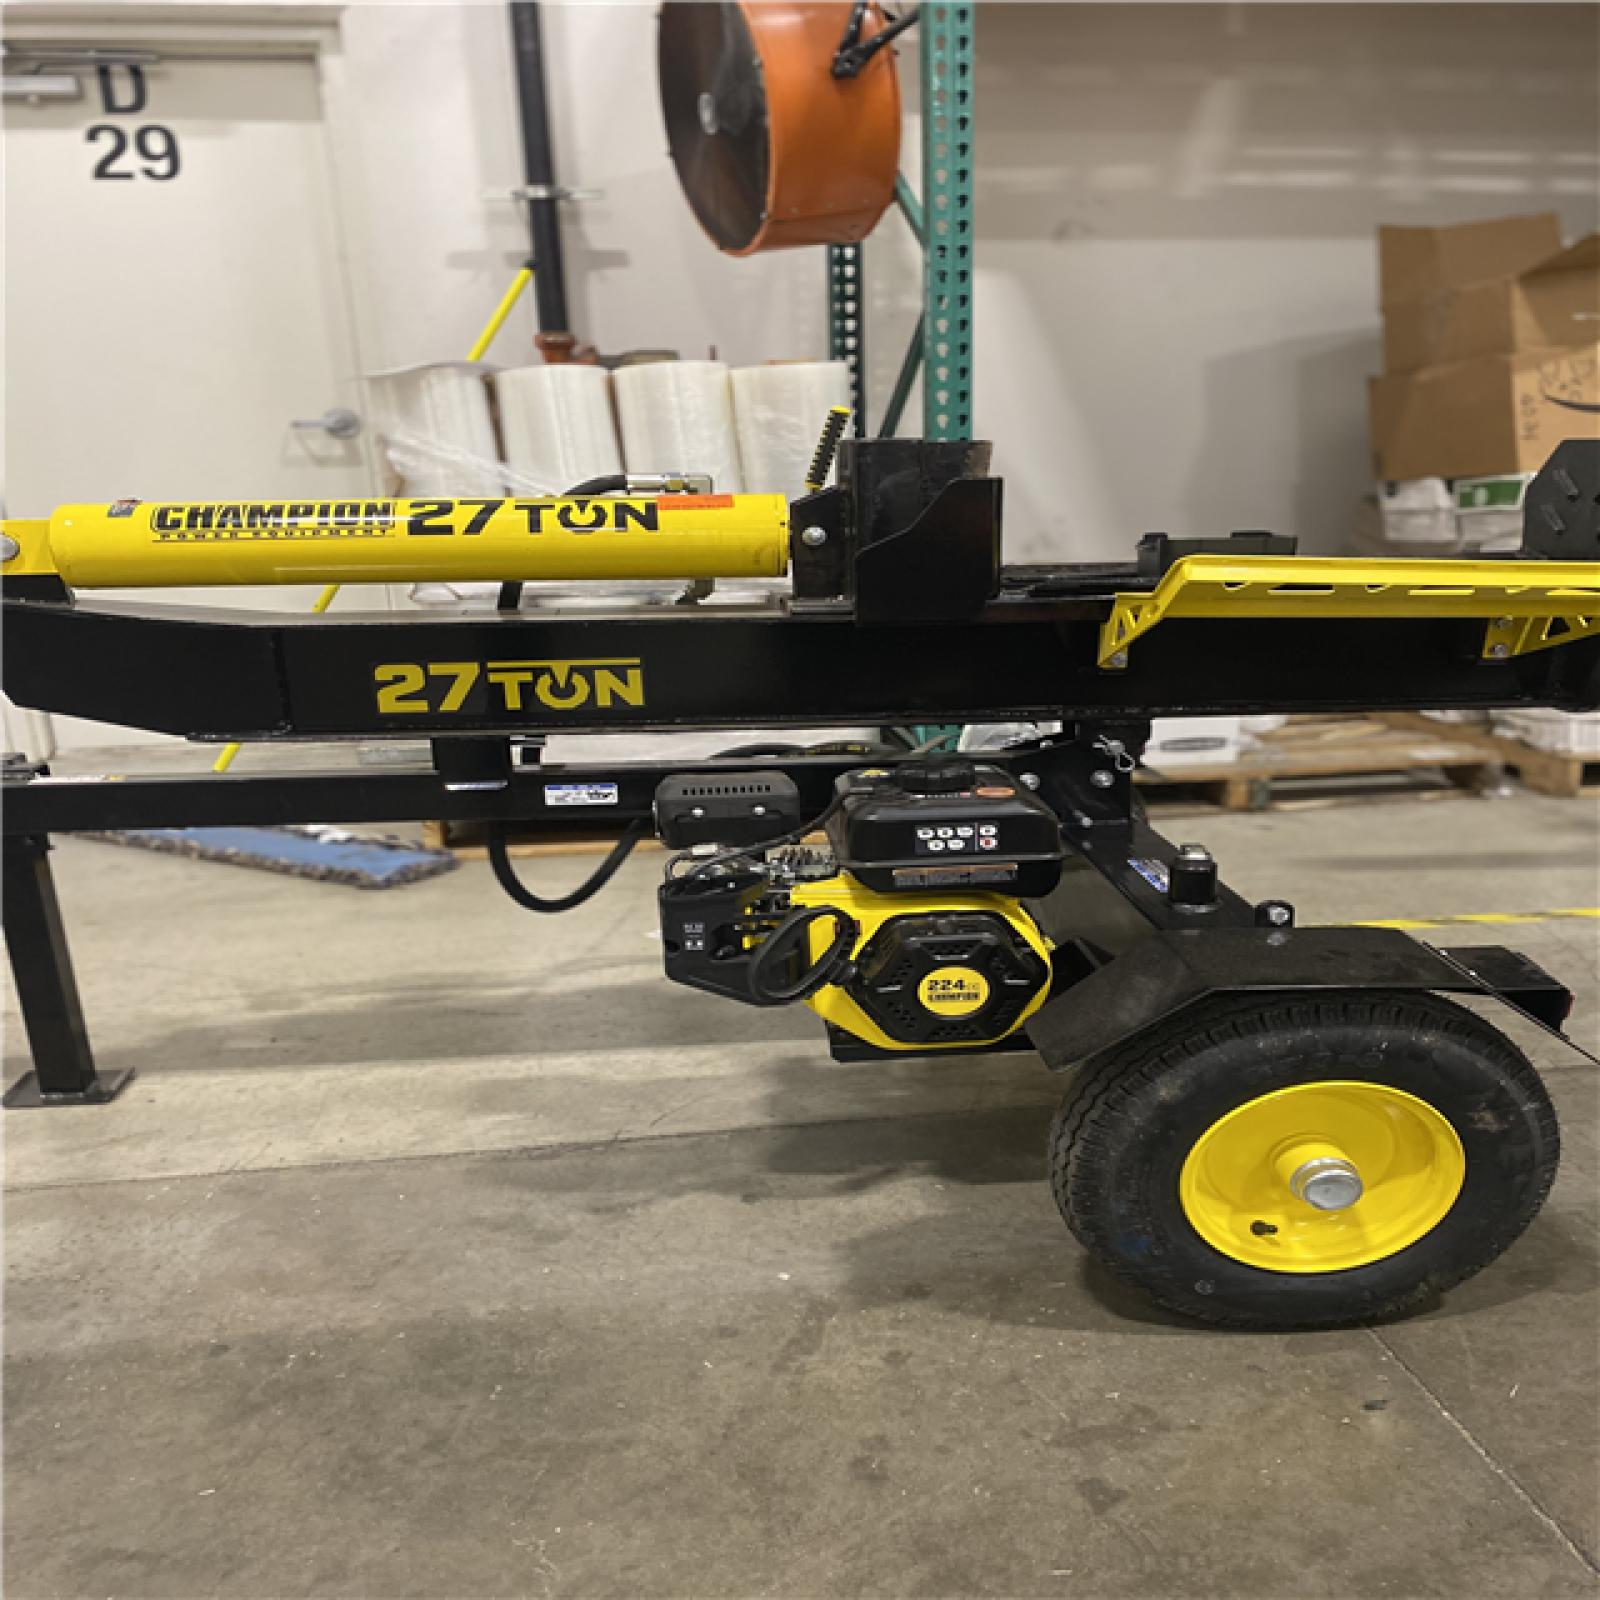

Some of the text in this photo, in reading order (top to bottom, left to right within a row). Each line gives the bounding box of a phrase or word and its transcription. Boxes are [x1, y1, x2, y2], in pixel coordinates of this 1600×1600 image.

[97, 64, 146, 113] D
[85, 124, 181, 181] 29
[151, 502, 394, 531] CHAMPION
[408, 499, 658, 536] 27 TON
[374, 660, 645, 713] 27 TON
